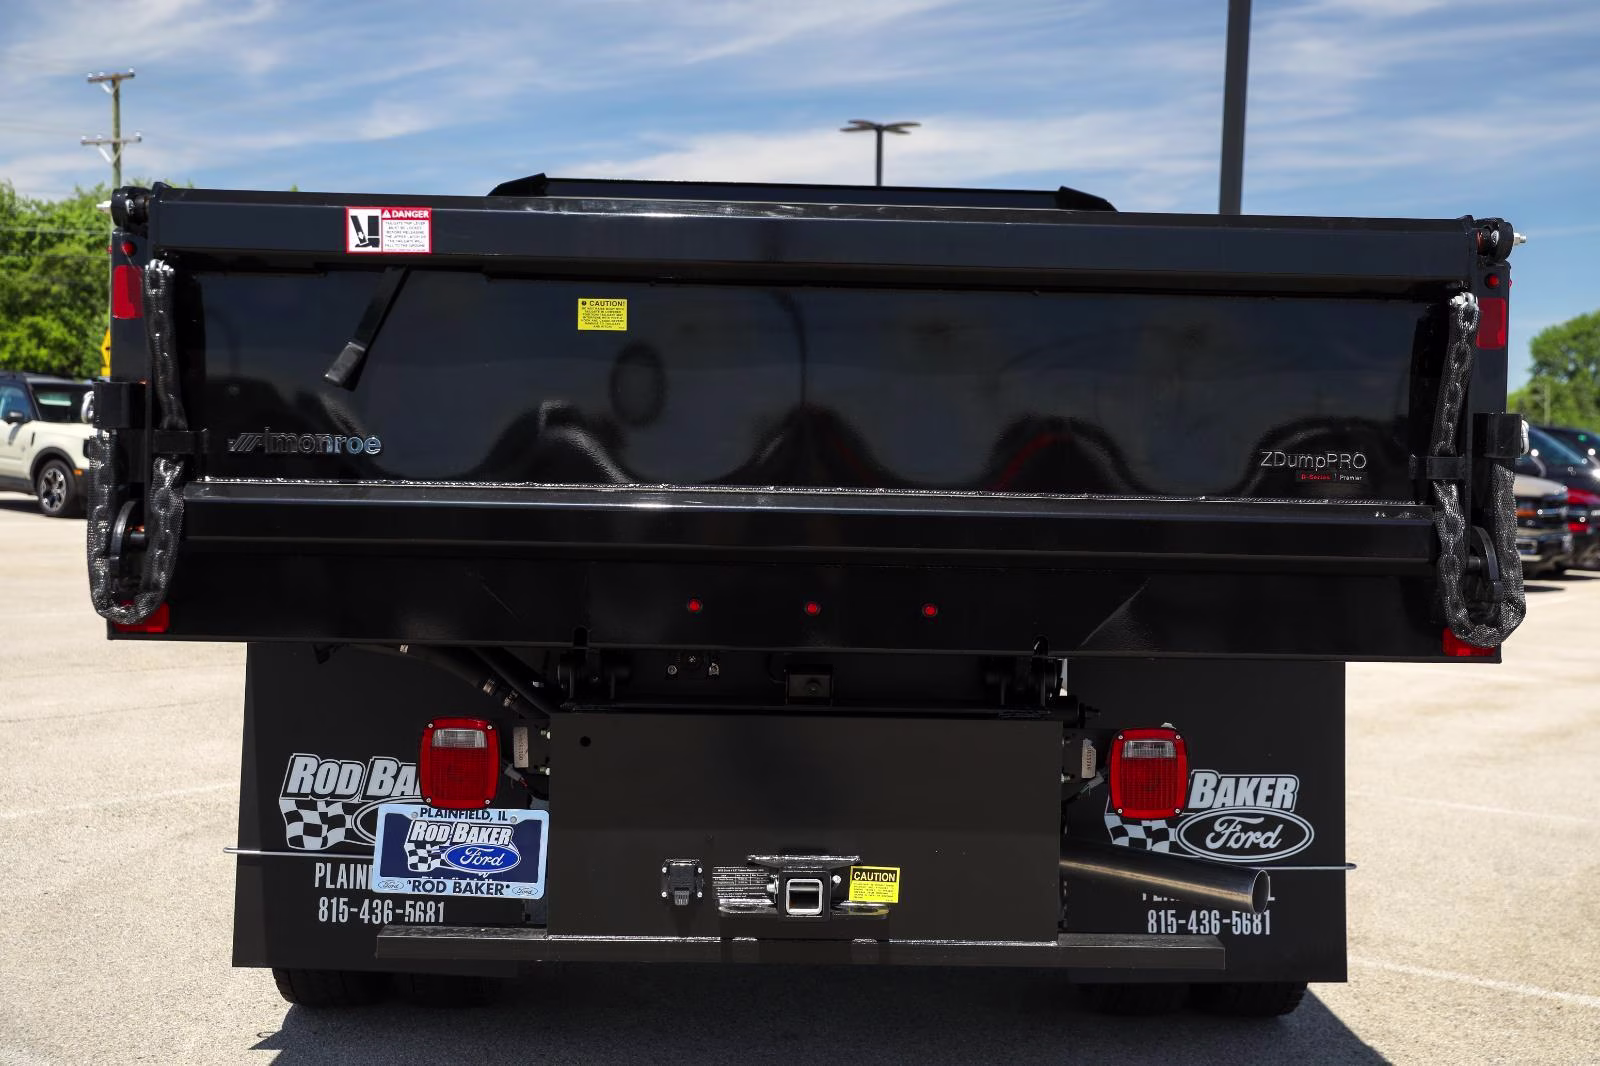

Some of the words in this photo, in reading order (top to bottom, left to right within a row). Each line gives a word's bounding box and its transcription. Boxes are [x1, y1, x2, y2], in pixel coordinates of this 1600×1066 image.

[391, 210, 429, 218] DANGER
[1260, 451, 1367, 472] ZDumpPRO
[286, 756, 363, 796] ROD
[366, 759, 421, 797] BA
[1188, 772, 1297, 810] BAKER
[420, 807, 493, 822] PLAINFIELD,
[498, 810, 508, 822] IL
[409, 820, 451, 842] ROD
[452, 822, 512, 845] BAKER
[1205, 815, 1284, 850] Ford
[460, 846, 506, 867] Ford
[412, 879, 447, 894] ROD
[452, 881, 505, 896] BAKER
[853, 871, 896, 882] CAUTION
[318, 896, 446, 925] 815-436-5681
[1147, 909, 1271, 936] 815-436-5681
